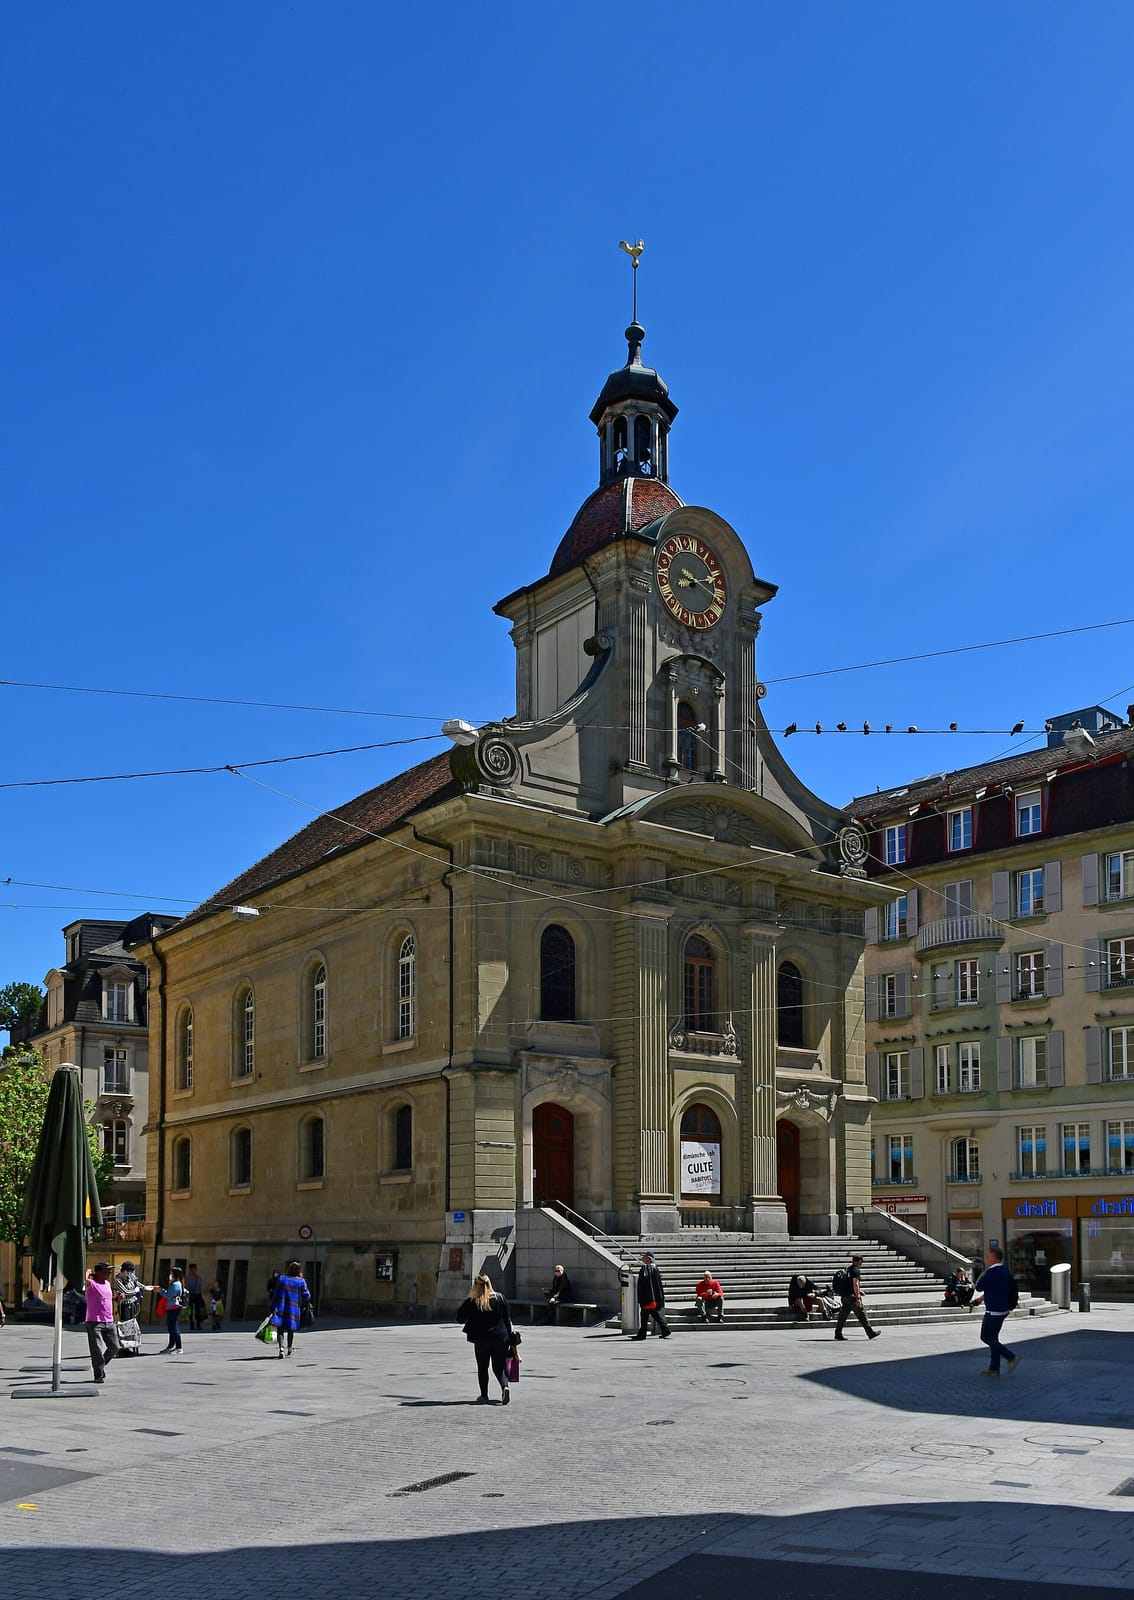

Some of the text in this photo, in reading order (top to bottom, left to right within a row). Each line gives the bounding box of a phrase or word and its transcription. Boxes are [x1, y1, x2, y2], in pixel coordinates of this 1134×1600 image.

[687, 1161, 713, 1174] CULTE
[885, 1203, 897, 1213] ici
[1016, 1199, 1057, 1216] drafil
